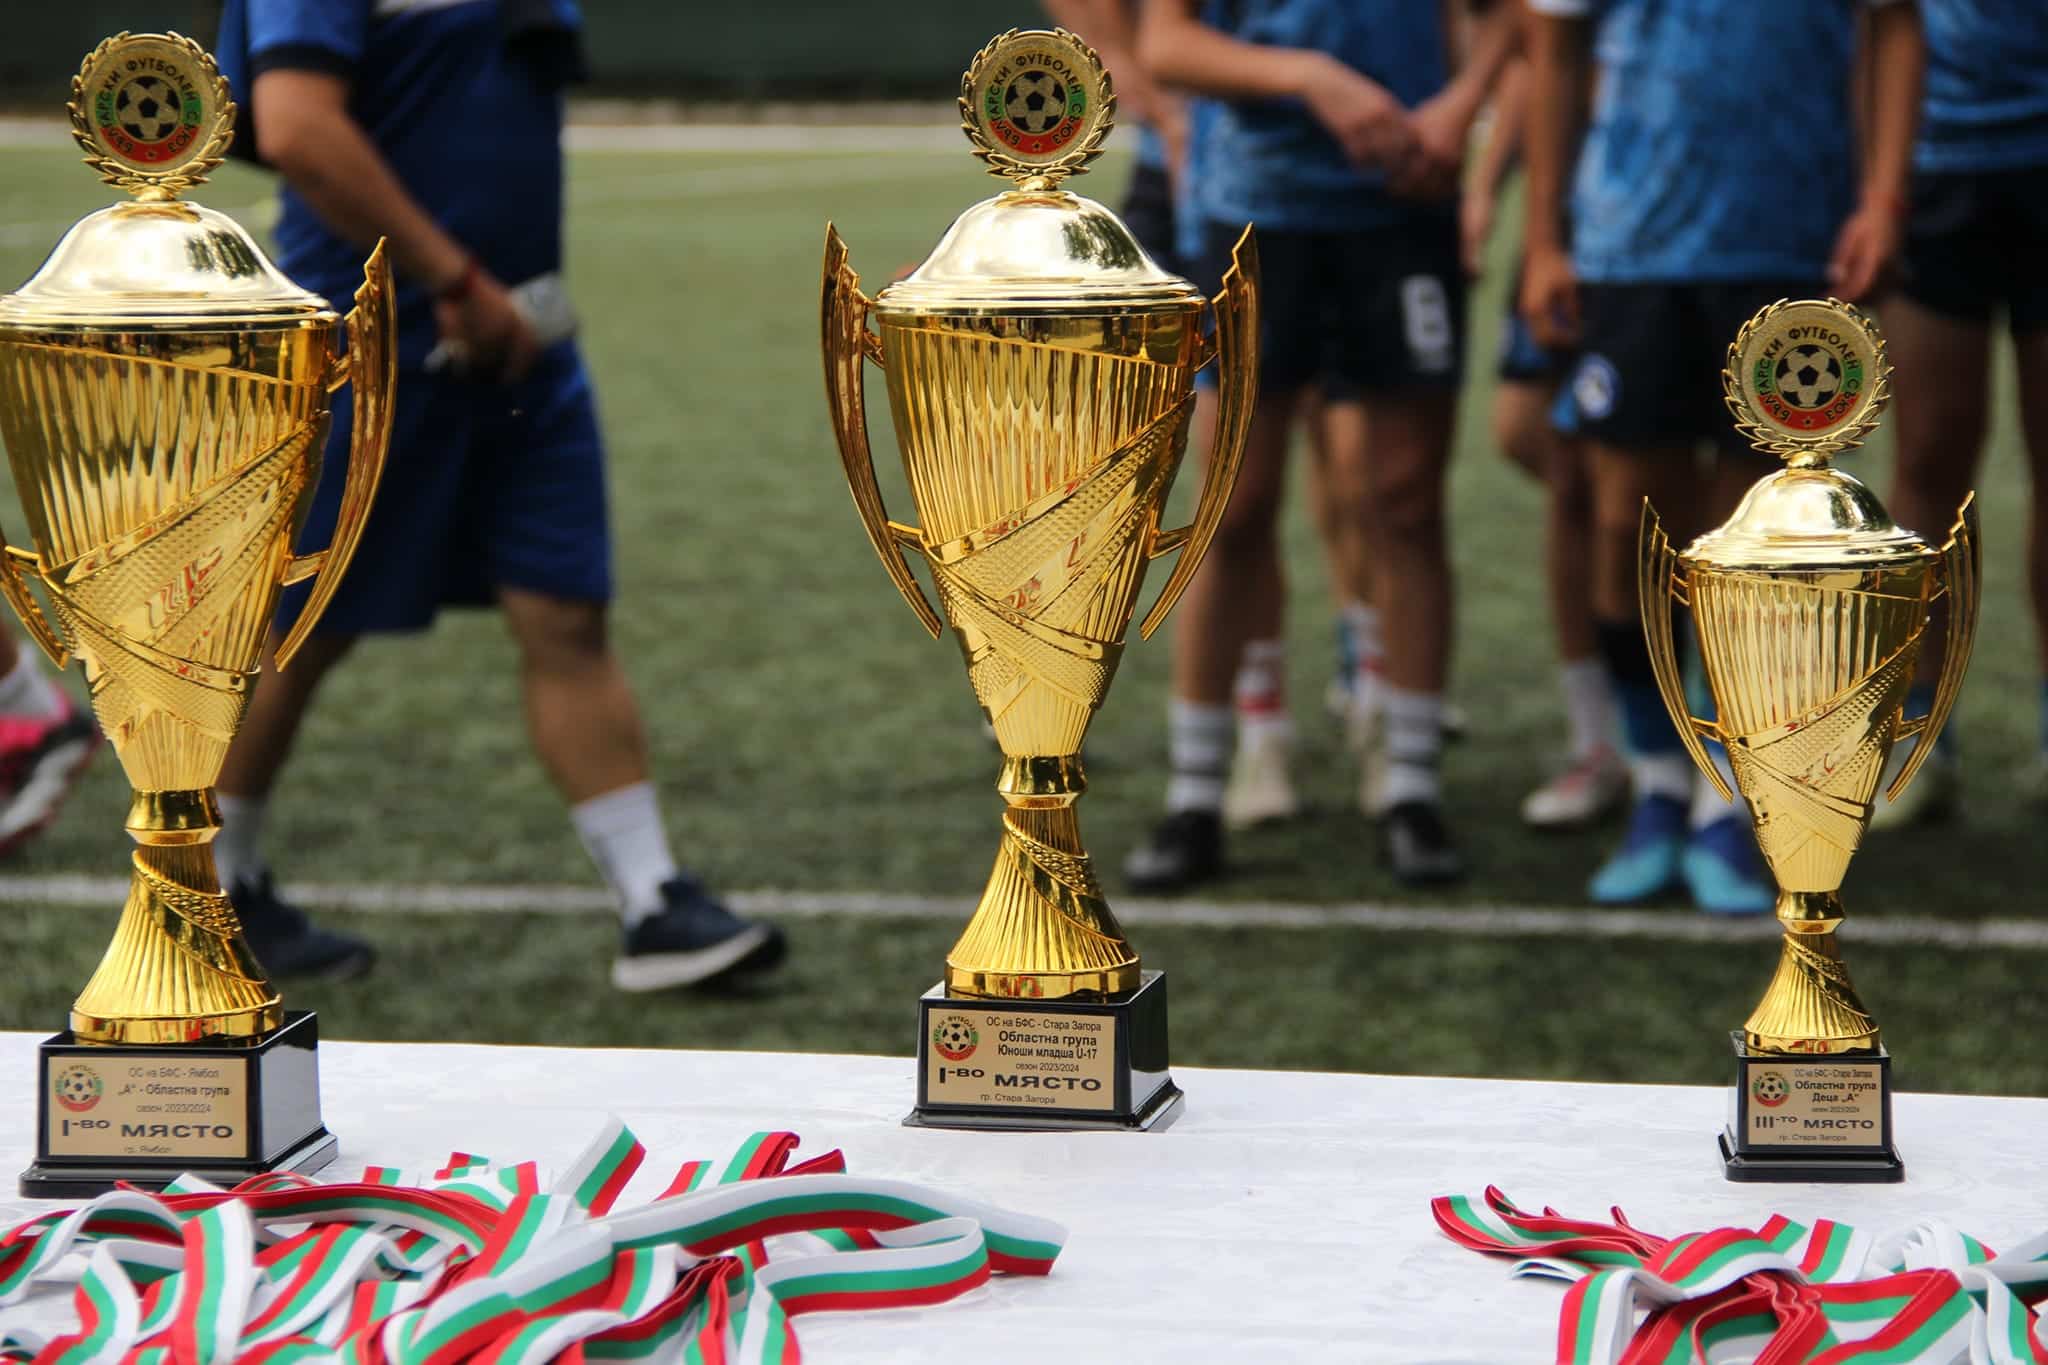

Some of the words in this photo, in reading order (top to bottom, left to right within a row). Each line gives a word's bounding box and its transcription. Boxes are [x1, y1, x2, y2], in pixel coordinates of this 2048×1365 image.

[126, 57, 197, 101] ФУТБОЛЕН
[1015, 53, 1082, 94] ФУТБОЛЕН
[1052, 105, 1082, 144] СЪЮЗ
[1788, 326, 1858, 370] ФУТБОЛЕН
[986, 1016, 1000, 1026] ОС
[1003, 1018, 1013, 1027] на
[1015, 1017, 1035, 1028] БФС
[1043, 1018, 1070, 1031] Стара
[1072, 1020, 1102, 1032] Загора
[999, 1030, 1059, 1045] Областна
[1062, 1035, 1097, 1048] група
[998, 1043, 1034, 1056] Юноши
[1036, 1048, 1074, 1059] младша
[1076, 1048, 1097, 1060] U-17
[1039, 1062, 1080, 1073] 2023/2024
[145, 1083, 198, 1096] Областна
[200, 1087, 230, 1098] група
[1795, 1080, 1845, 1090] Областна
[1847, 1082, 1877, 1092] група
[995, 1093, 1022, 1103] Стара
[1026, 1094, 1056, 1104] Загора
[1812, 1092, 1839, 1103] Деца
